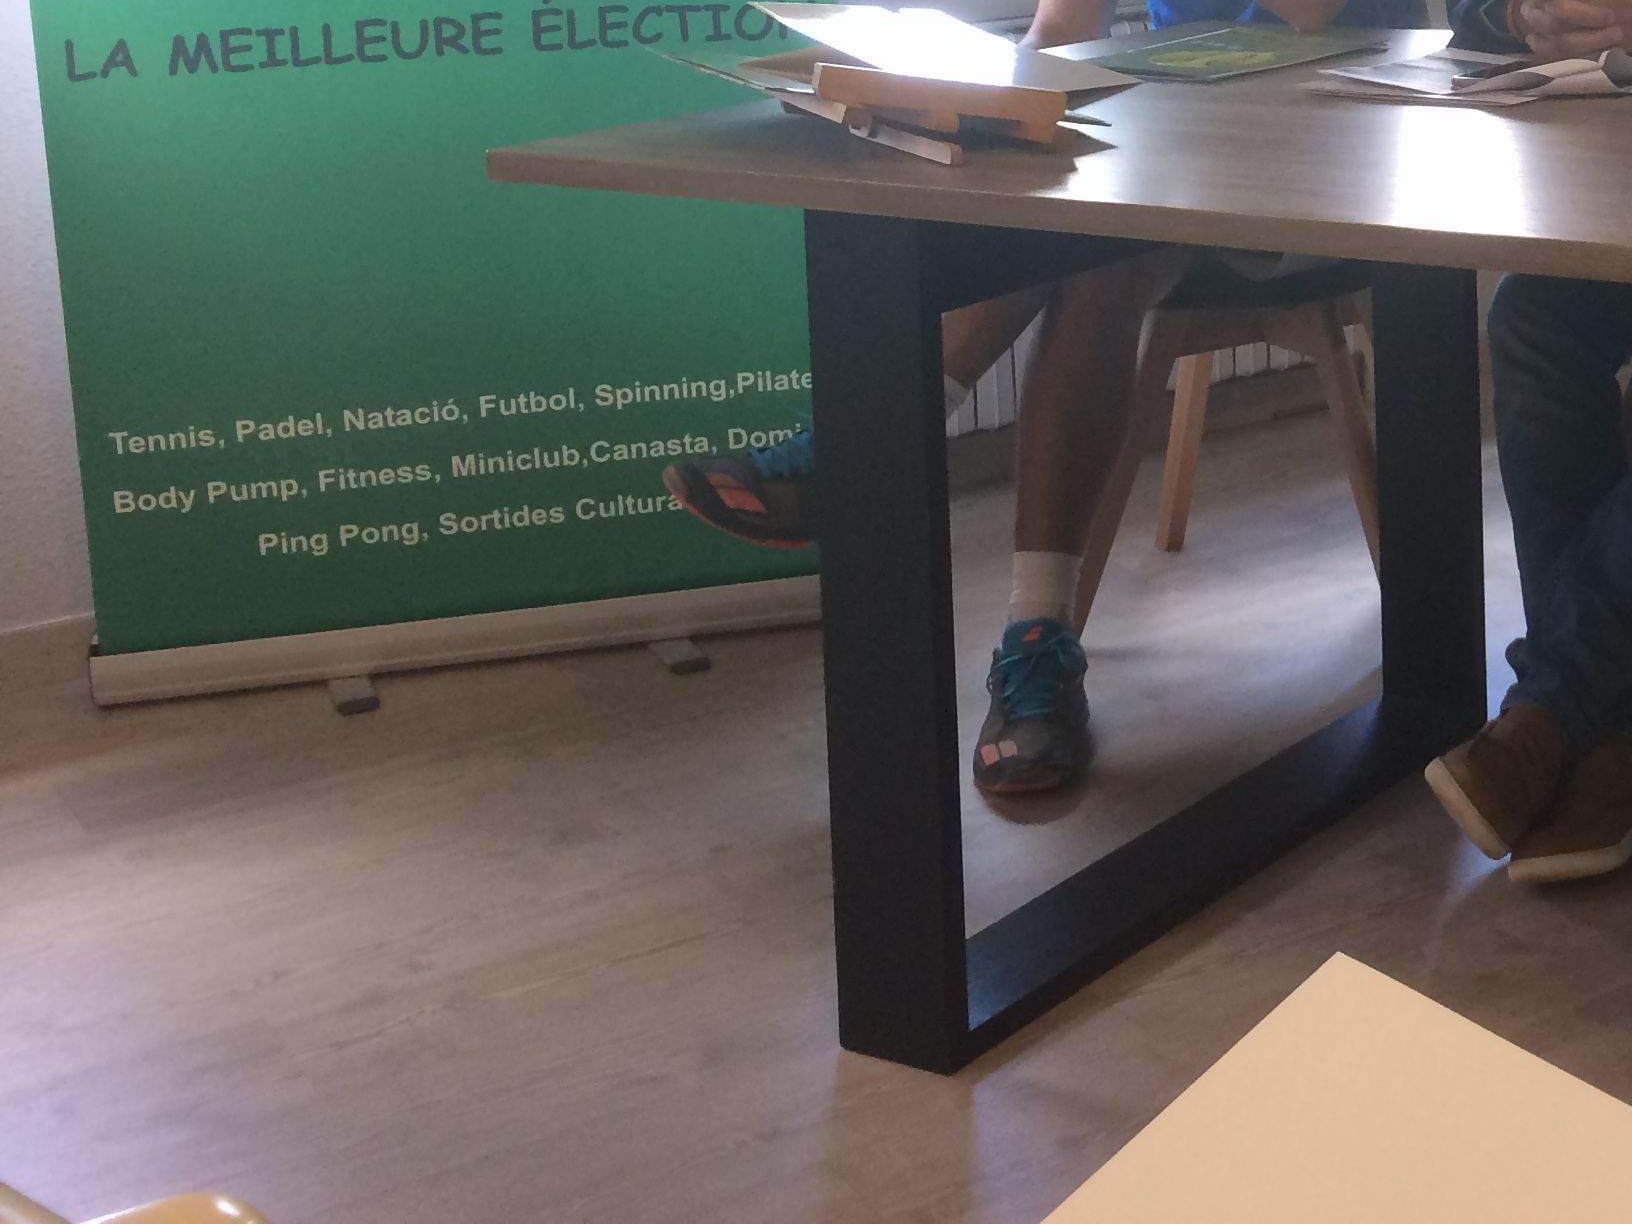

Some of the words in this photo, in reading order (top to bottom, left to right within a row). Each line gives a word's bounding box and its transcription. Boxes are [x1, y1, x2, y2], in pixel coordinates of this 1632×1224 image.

[64, 38, 137, 83] LA
[169, 11, 504, 77] MEILLEURE
[109, 427, 226, 455] Tennis,
[236, 413, 333, 443] Padel,
[343, 398, 469, 432] Natació,
[480, 388, 585, 418] Futbol,
[113, 486, 195, 514] Body
[208, 476, 308, 504] Pump,
[319, 463, 441, 493] Fitness,
[728, 423, 802, 451] Dom
[258, 532, 328, 557] Ping
[340, 520, 429, 547] Pong,
[439, 503, 565, 535] Sortides
